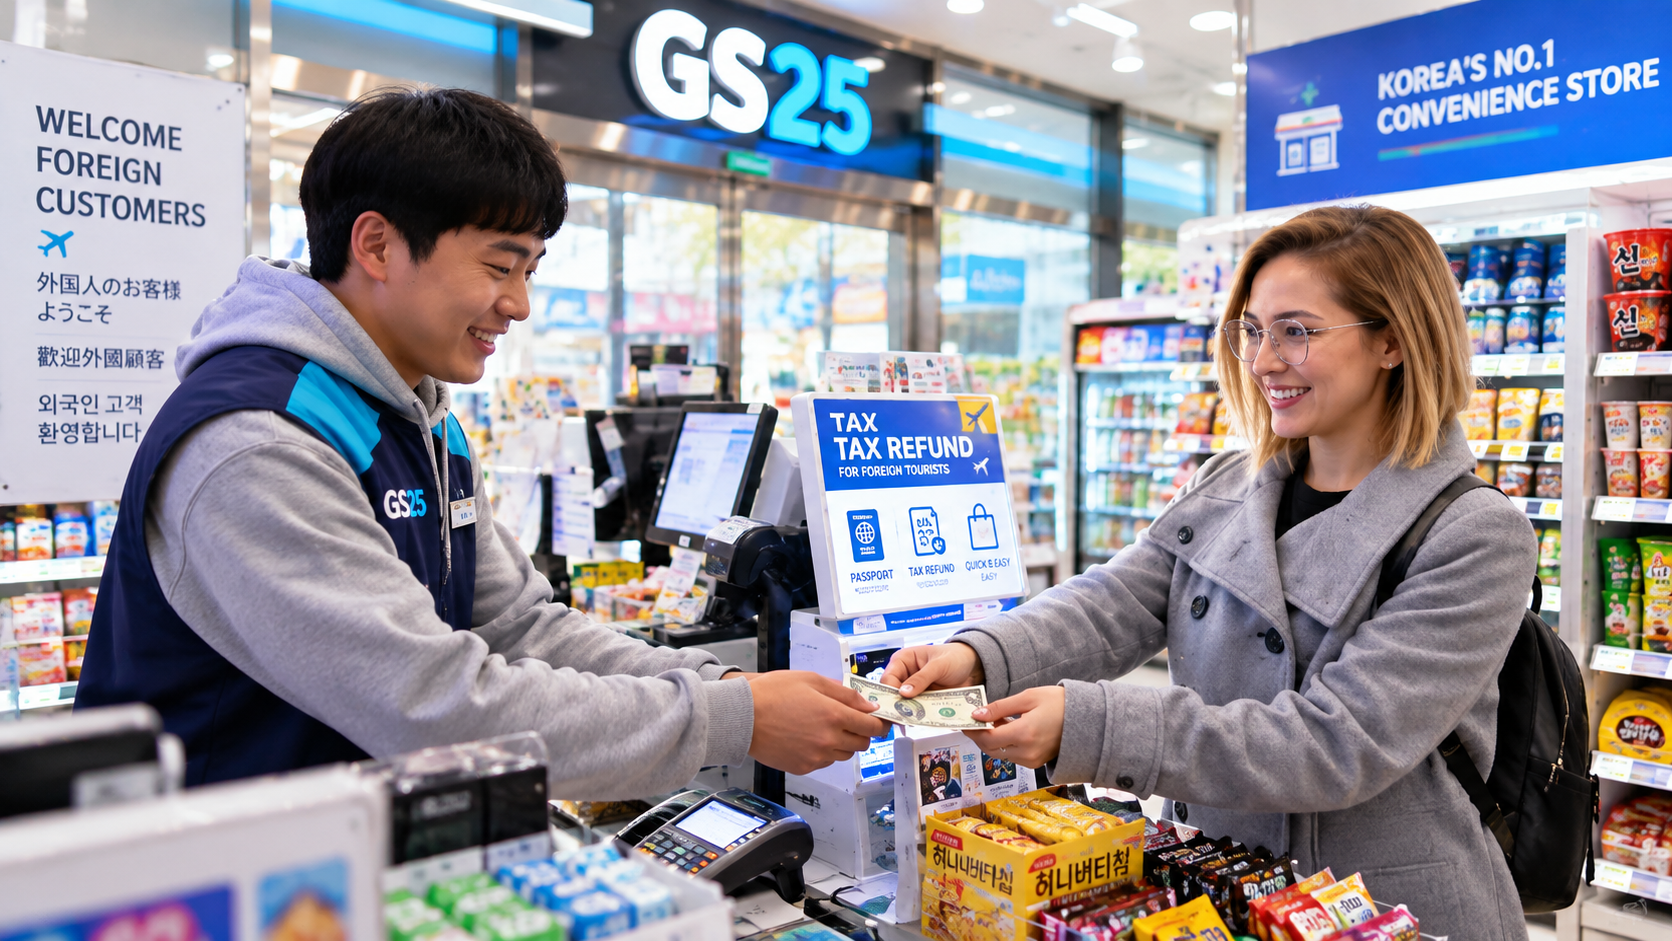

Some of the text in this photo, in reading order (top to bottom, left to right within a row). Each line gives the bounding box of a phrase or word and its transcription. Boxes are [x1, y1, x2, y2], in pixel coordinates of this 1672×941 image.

[631, 8, 872, 156] GS25
[1377, 38, 1555, 100] KOREA'S NO.1
[1376, 57, 1660, 135] CONVENIENCE STORE
[35, 105, 182, 151] WELCOME
[37, 146, 161, 186] FOREIGN
[36, 186, 206, 228] CUSTOMERS
[1614, 244, 1640, 275] 신
[37, 271, 181, 300] 外国人のお客様
[38, 301, 112, 324] ようこそ
[1613, 306, 1639, 337] 신
[37, 346, 165, 369] 歡迎外國顧客
[38, 393, 142, 415] 외국인 고객
[38, 421, 142, 445] 환영합니다
[829, 412, 879, 433] TAX
[833, 435, 974, 461] TAX REFUND
[839, 463, 950, 478] FOR FOREIGN TOURISTS
[383, 488, 427, 519] GS25
[908, 563, 955, 577] TAX REFUND
[994, 557, 1010, 568] EASY
[850, 569, 894, 583] PASSPORT
[981, 572, 997, 582] EASY
